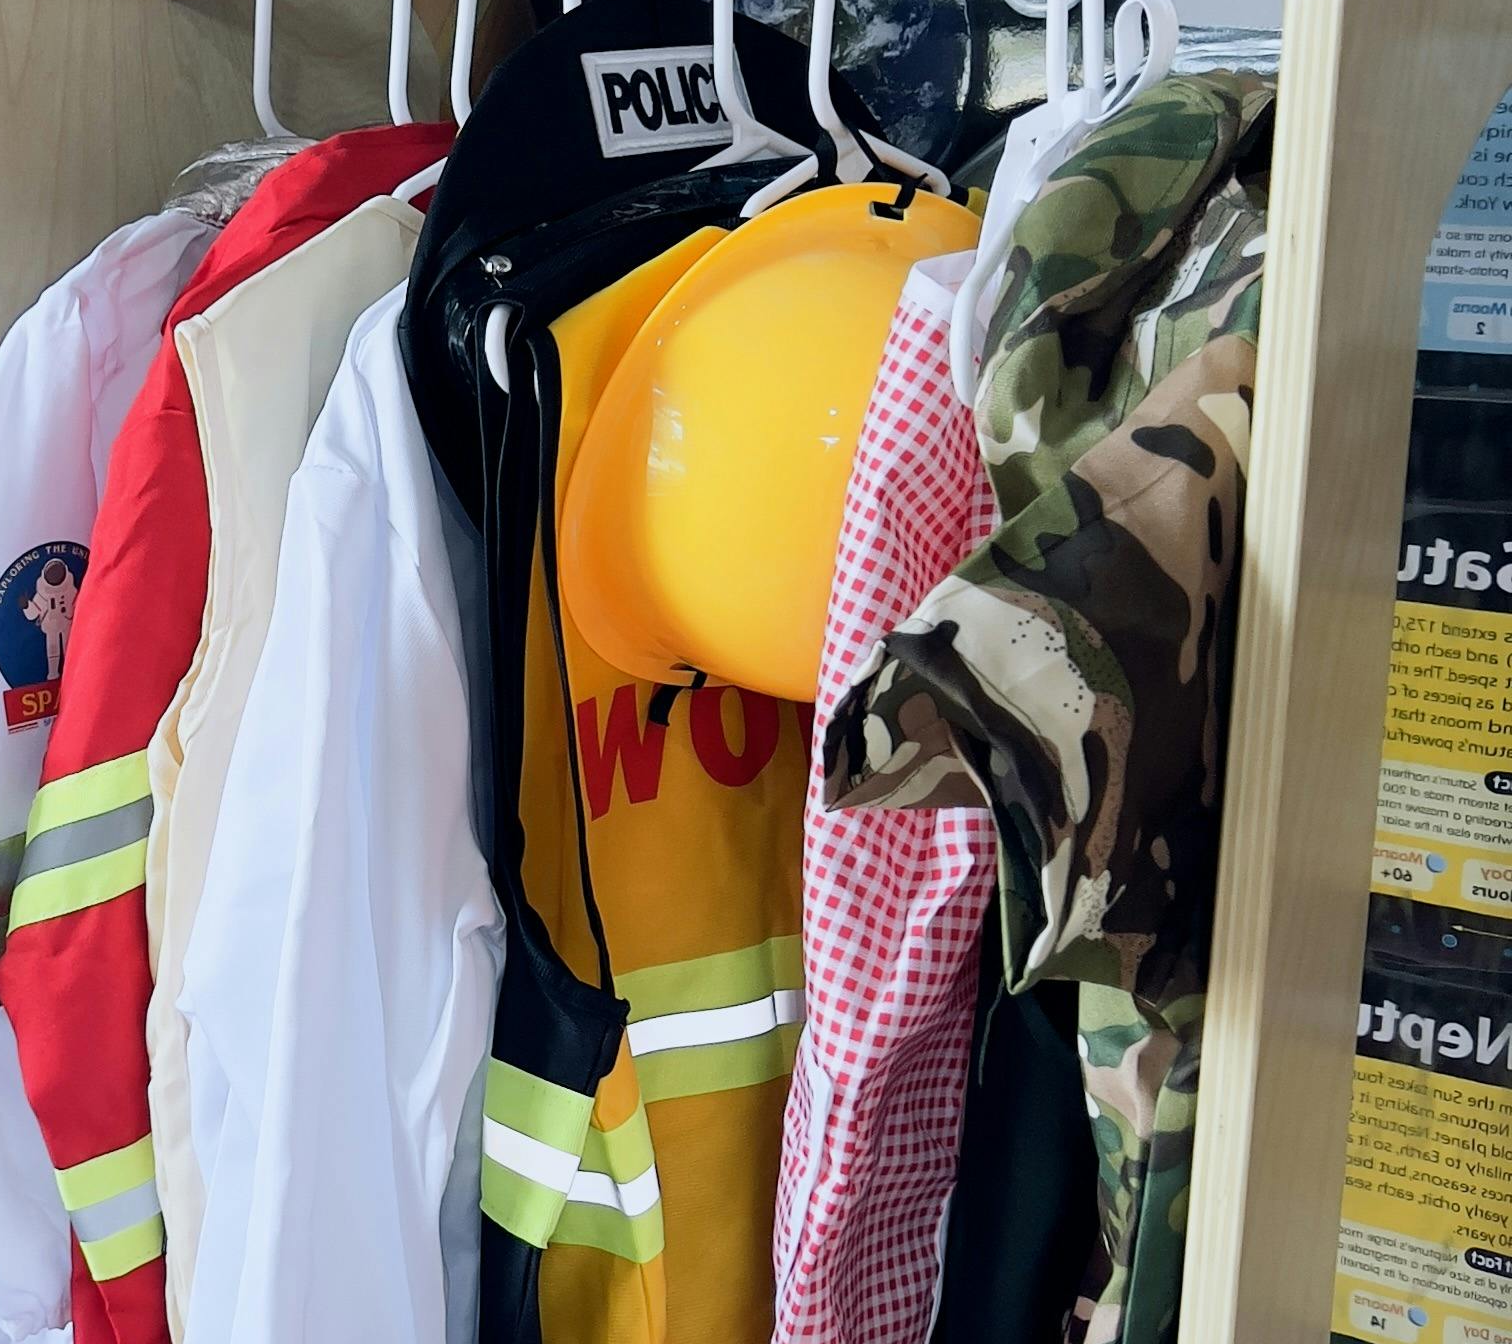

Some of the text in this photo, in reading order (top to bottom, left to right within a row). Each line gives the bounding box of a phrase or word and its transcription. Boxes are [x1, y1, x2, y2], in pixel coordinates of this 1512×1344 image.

[601, 62, 730, 134] POLIC
[45, 543, 67, 555] THE
[21, 688, 61, 717] SP
[576, 682, 816, 823] WO
